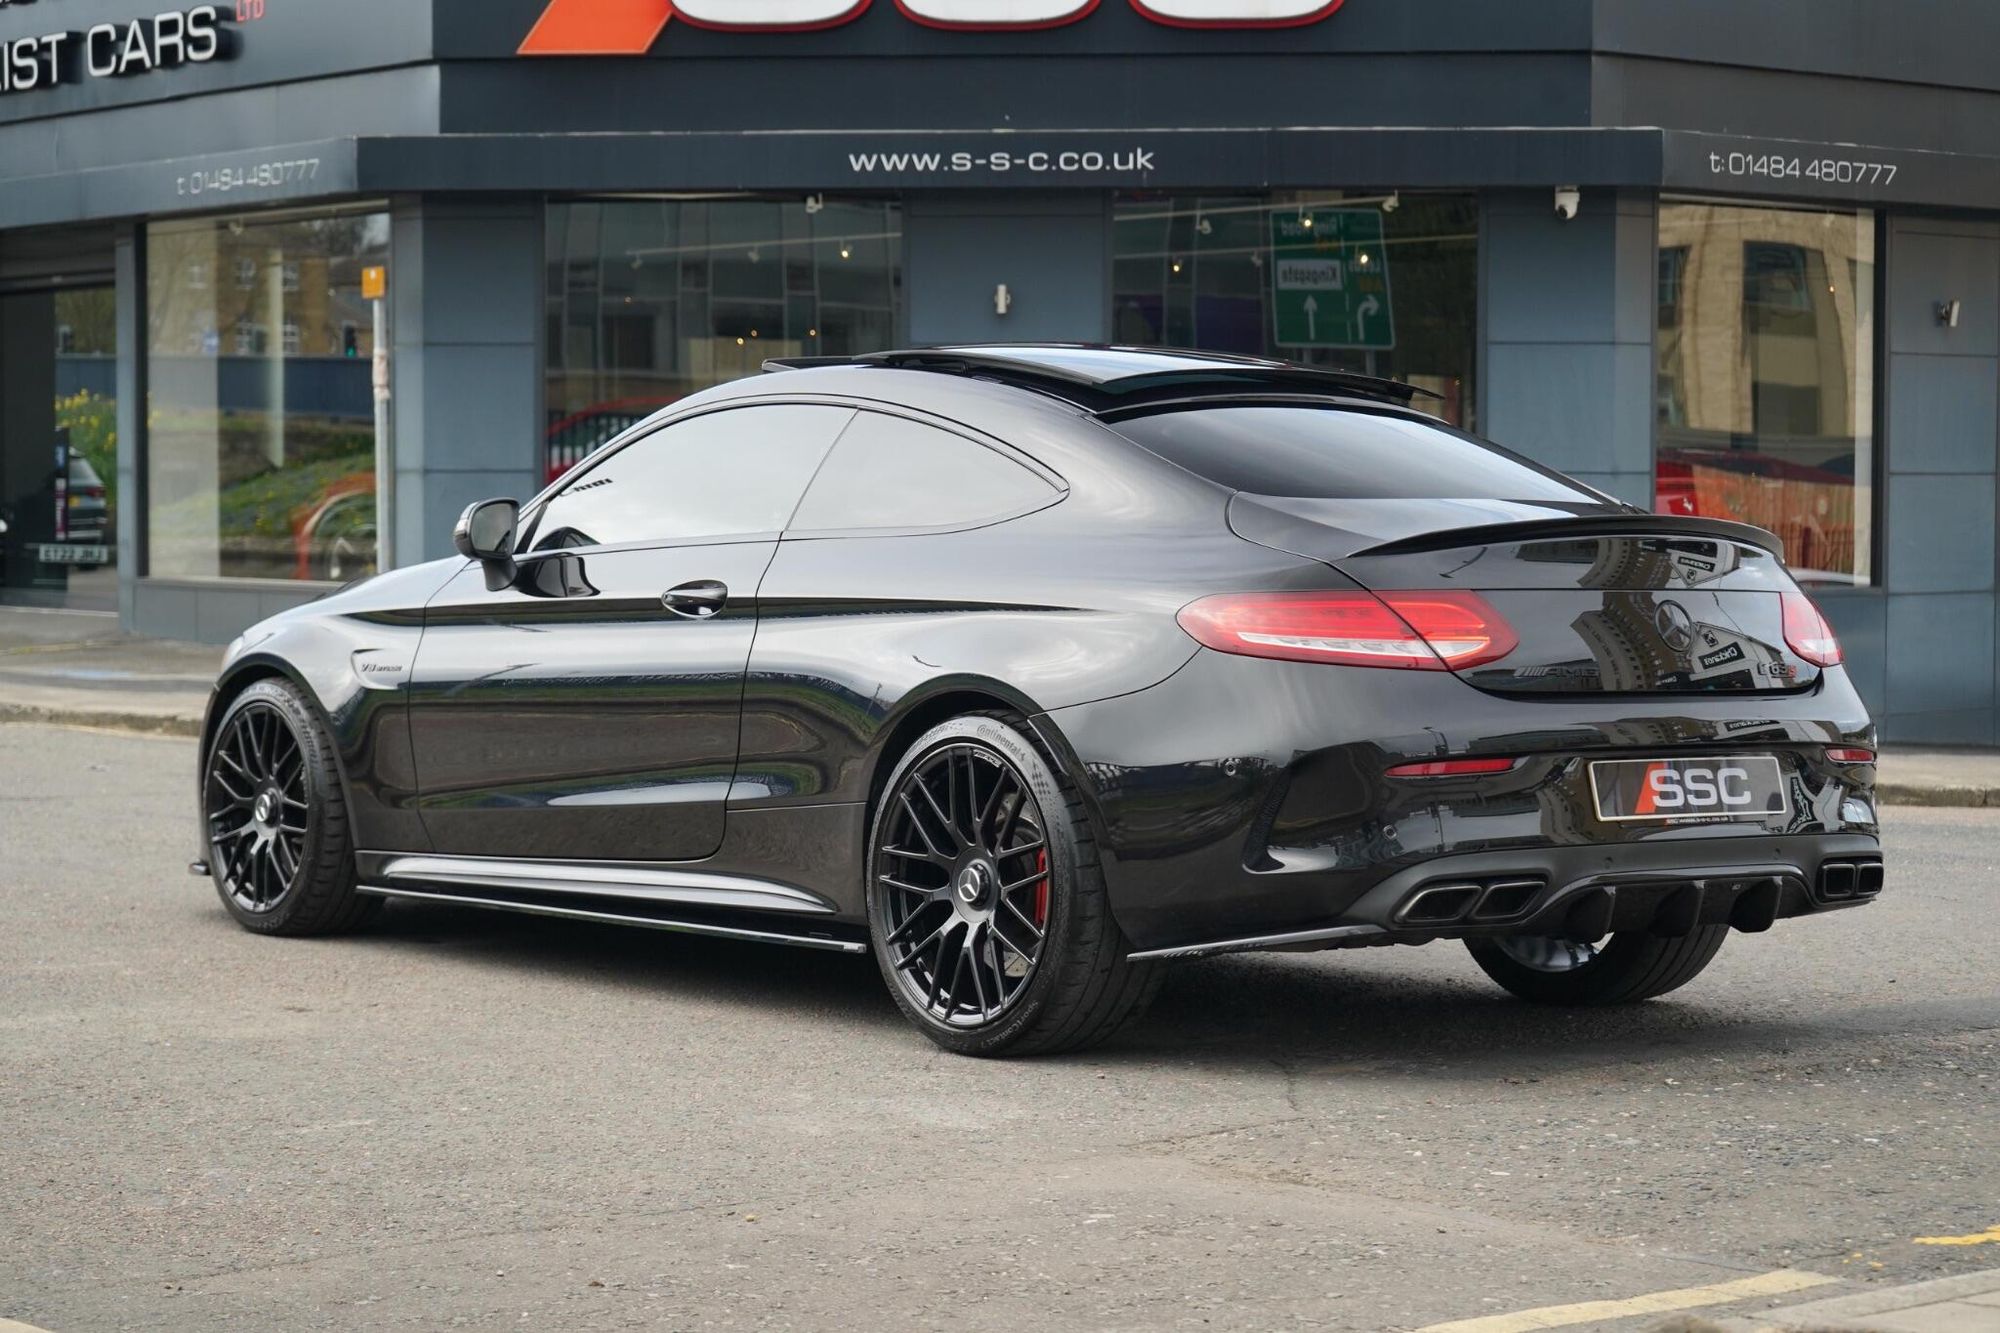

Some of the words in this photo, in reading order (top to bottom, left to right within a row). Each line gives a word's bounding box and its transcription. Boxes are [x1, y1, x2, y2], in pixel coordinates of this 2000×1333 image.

[0, 32, 67, 91] IST
[87, 6, 217, 77] CARS
[849, 147, 1154, 171] www.s-s-c.co.uk
[1710, 152, 1800, 178] t:01484
[1805, 159, 1897, 185] 480777
[177, 168, 244, 195] t01484
[1650, 768, 1751, 807] SSC
